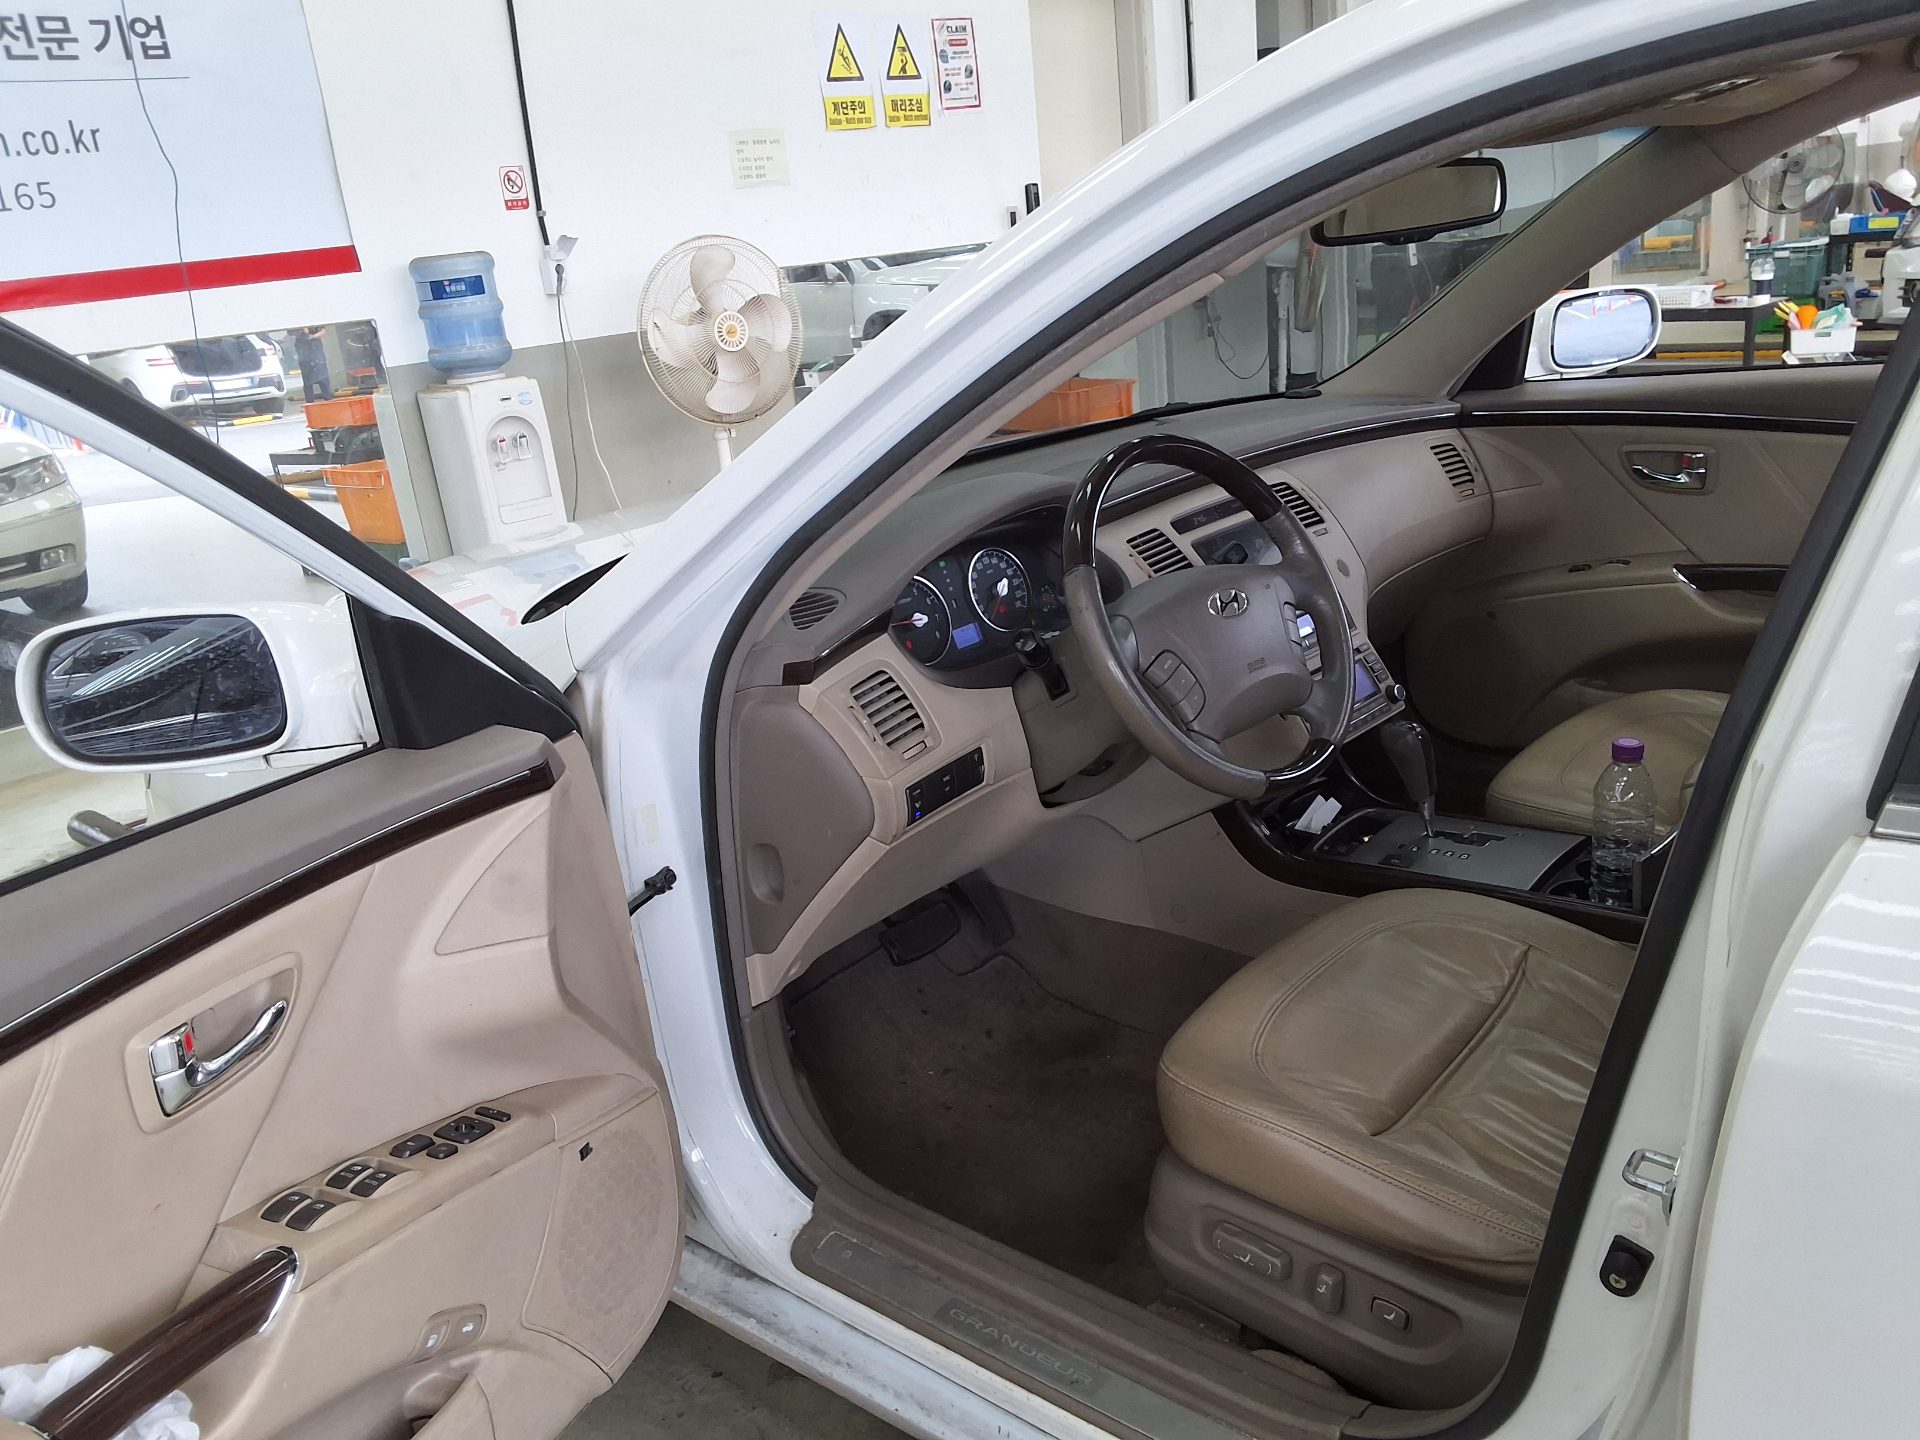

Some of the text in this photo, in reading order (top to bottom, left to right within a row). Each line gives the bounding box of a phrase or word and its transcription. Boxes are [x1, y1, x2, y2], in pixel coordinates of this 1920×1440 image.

[0, 13, 171, 61] 전문 기업
[946, 25, 967, 34] CLAIM
[831, 100, 866, 116] 계단주의
[890, 98, 923, 113] 머리조심
[949, 1308, 1093, 1386] GRANDEUR
